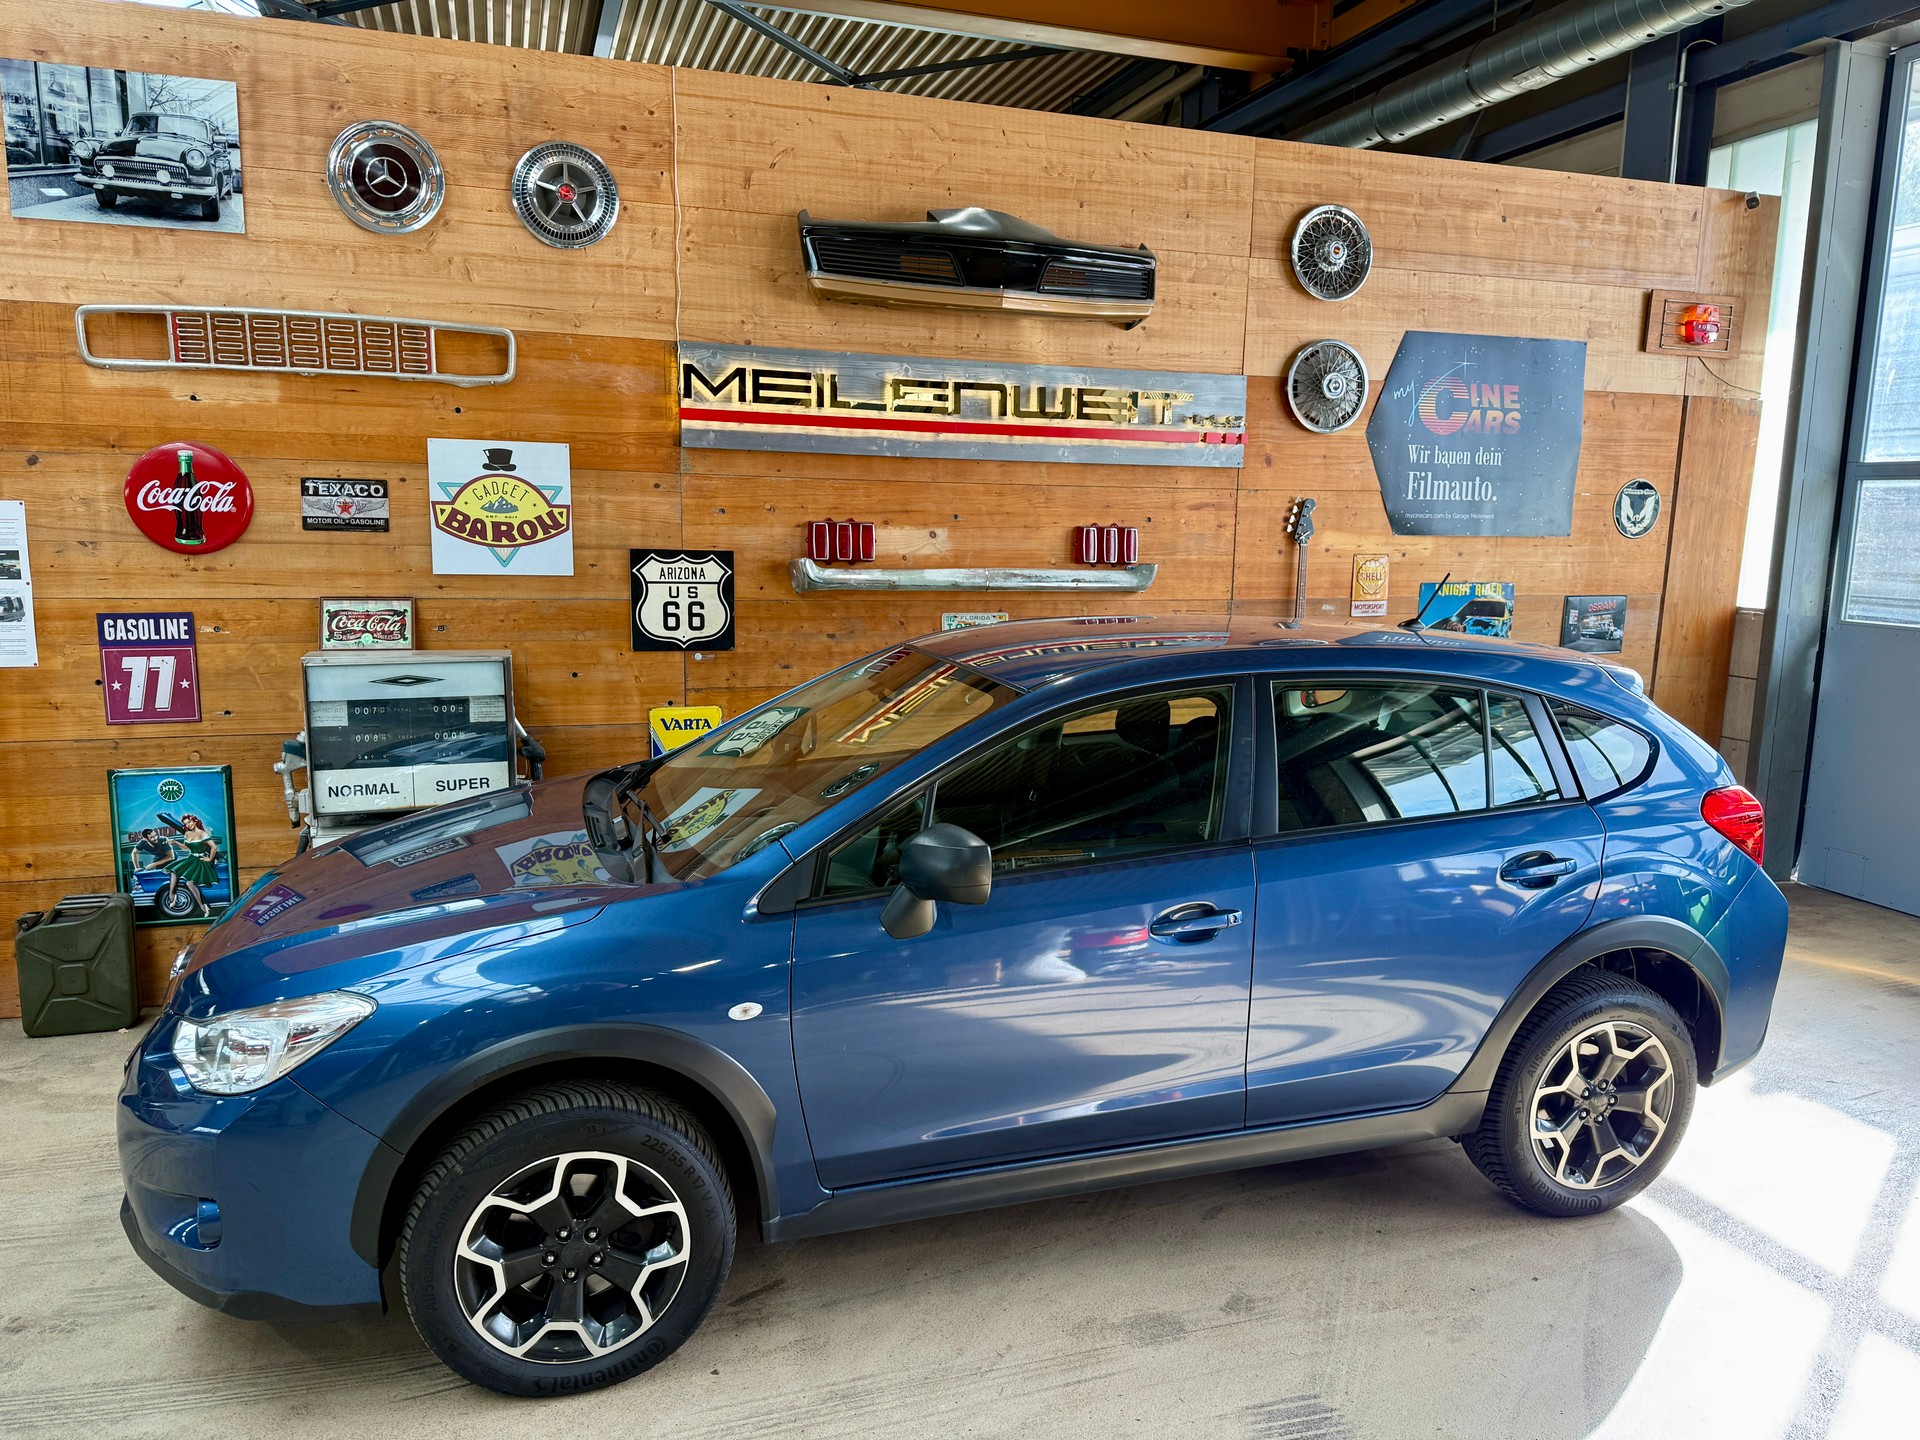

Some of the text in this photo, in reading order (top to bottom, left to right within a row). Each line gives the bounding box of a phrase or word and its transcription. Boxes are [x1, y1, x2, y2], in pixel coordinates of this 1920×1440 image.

[1408, 444, 1502, 466] Wir bauen dein
[136, 479, 237, 513] Coca-Cola
[304, 482, 384, 497] TEXACO
[472, 481, 529, 502] GADGET
[1406, 471, 1498, 502] Filmauto.
[349, 518, 385, 526] GASOLINE
[441, 507, 565, 543] BARON
[659, 566, 706, 580] ARIZONA
[1360, 572, 1383, 581] SHELL
[662, 601, 705, 631] 66
[1587, 600, 1617, 612] OSRAM
[103, 618, 190, 642] GASOLINE
[121, 655, 176, 712] 77
[660, 717, 713, 731] VARTA
[328, 782, 400, 798] NORMAL
[435, 777, 490, 792] SUPER
[1526, 1004, 1604, 1079] AllSeasonContact
[640, 1134, 687, 1168] 225/55
[684, 1165, 696, 1178] R
[692, 1175, 706, 1189] 17
